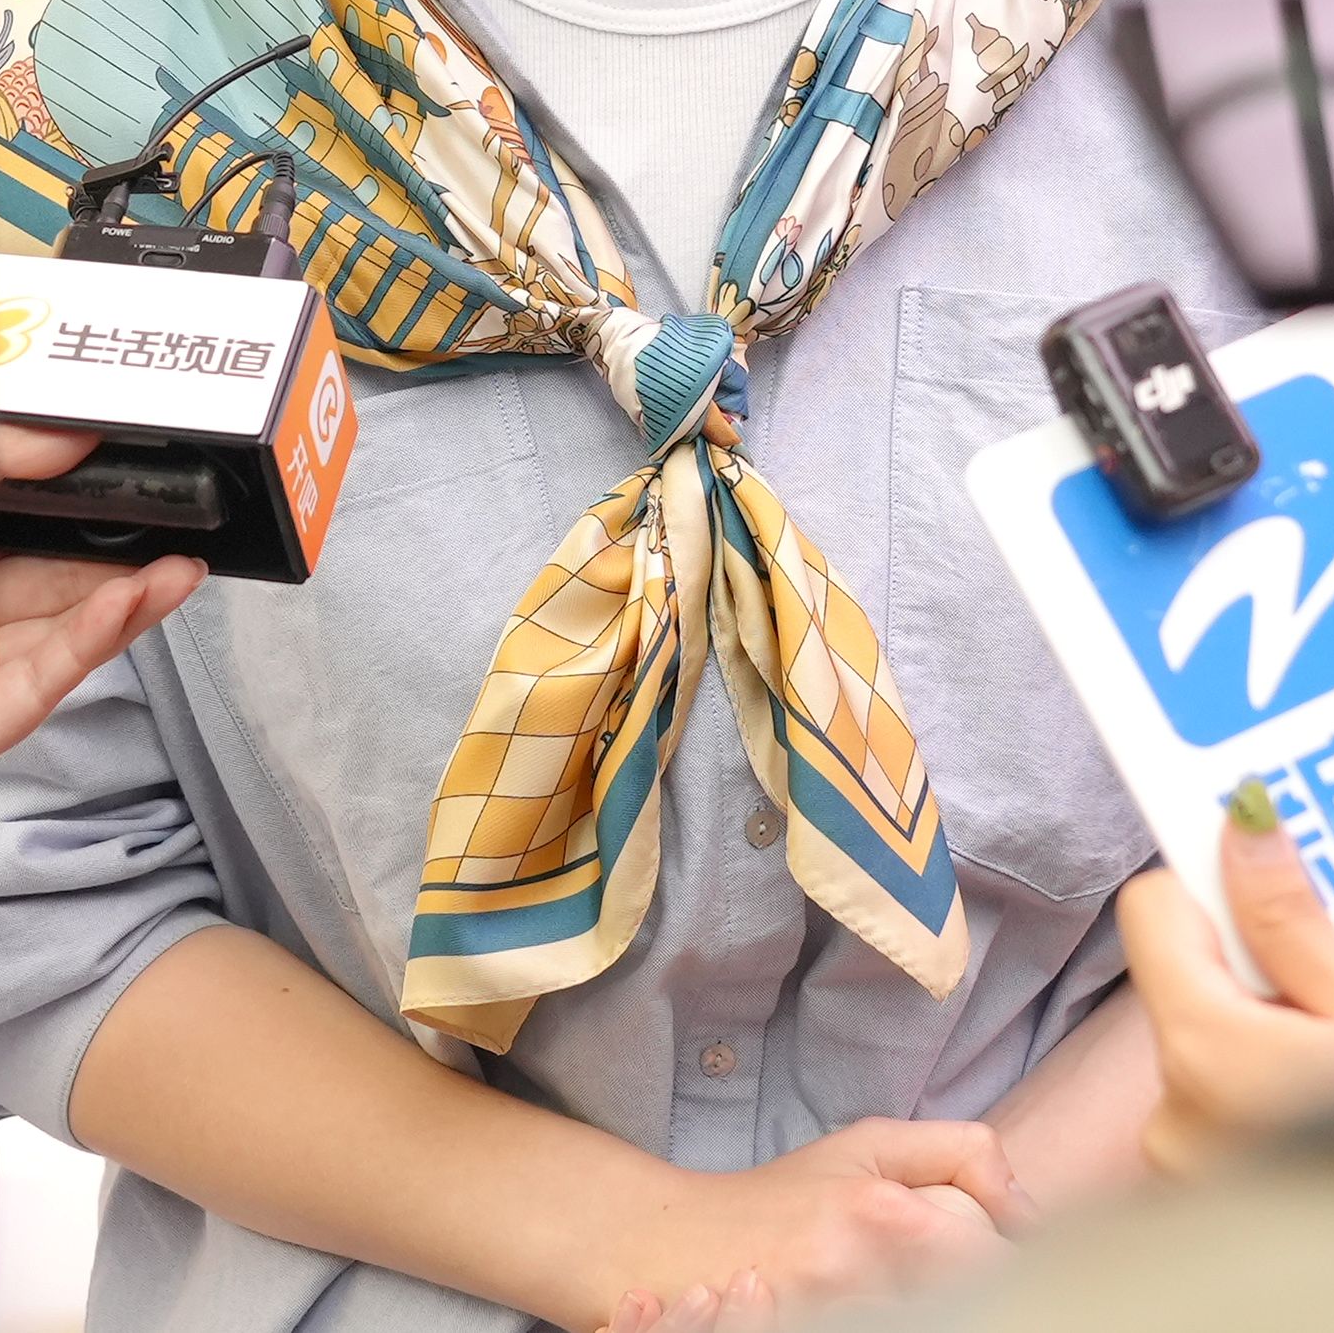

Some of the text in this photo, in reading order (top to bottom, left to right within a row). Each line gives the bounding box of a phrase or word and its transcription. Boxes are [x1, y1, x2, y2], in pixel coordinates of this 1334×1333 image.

[101, 226, 133, 238] POWE
[201, 234, 235, 245] AUDIO
[47, 321, 276, 380] 生活频道
[286, 433, 319, 534] 开吧
